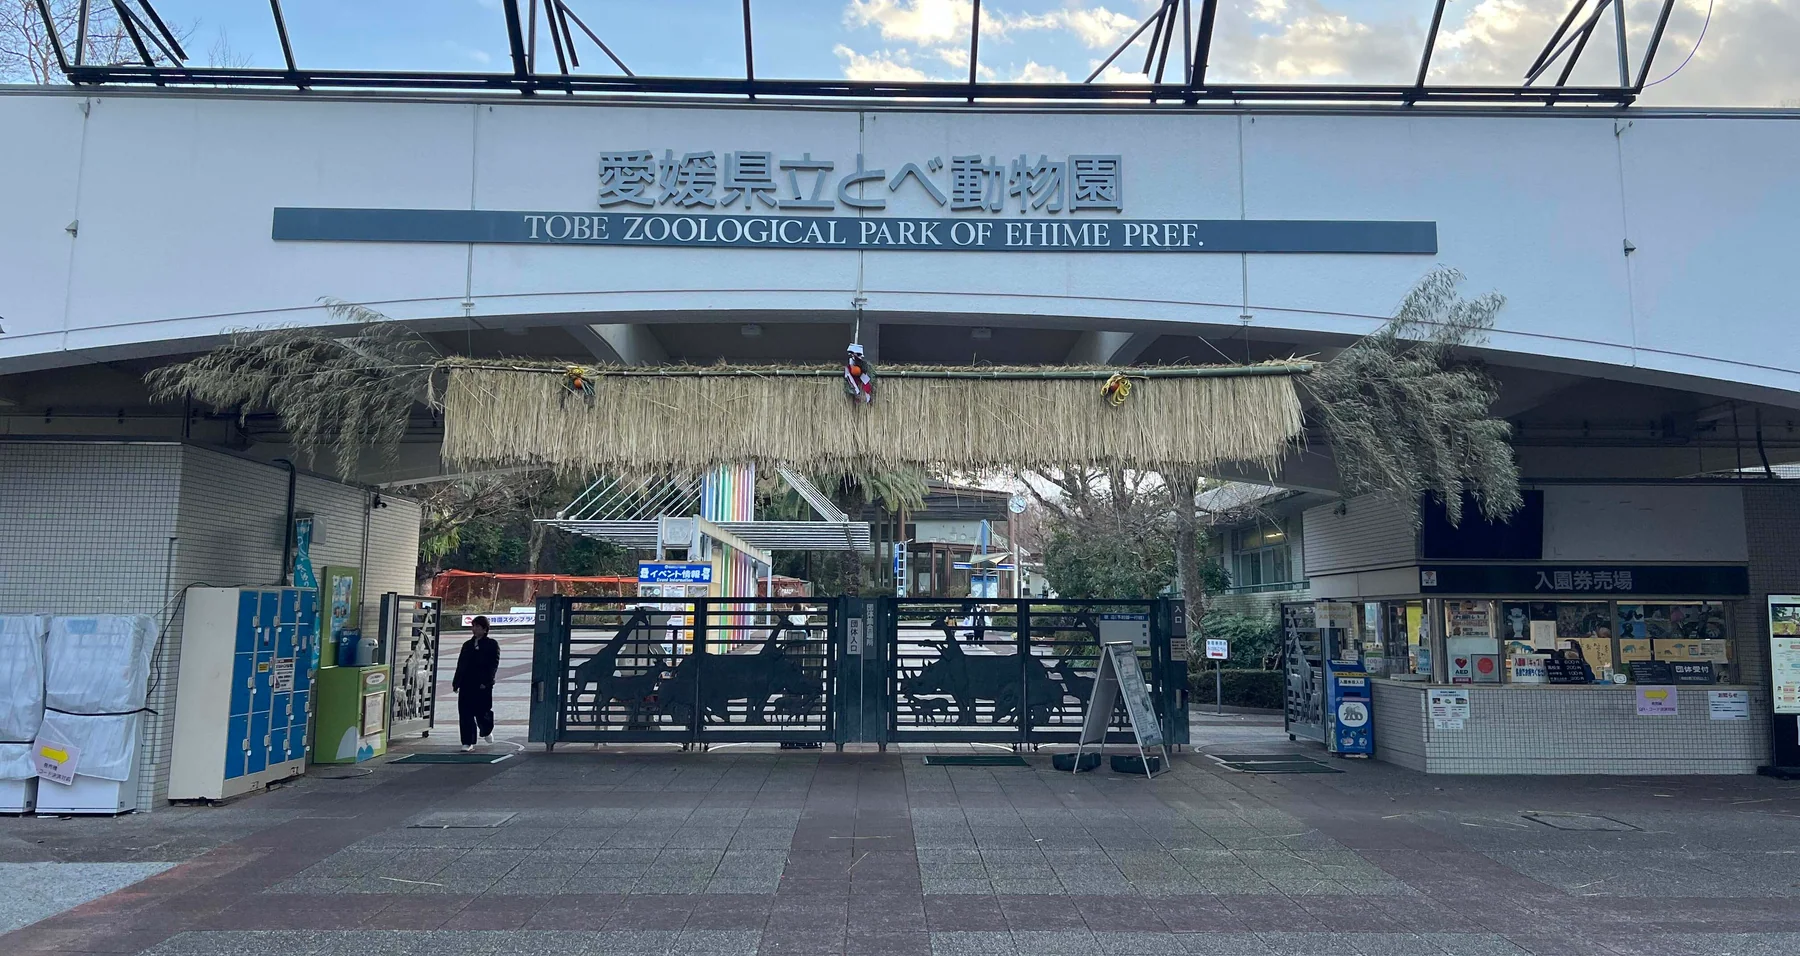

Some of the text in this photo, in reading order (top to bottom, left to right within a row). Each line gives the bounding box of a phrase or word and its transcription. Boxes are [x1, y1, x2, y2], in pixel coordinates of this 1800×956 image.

[598, 149, 1123, 213] 愛媛県立とべ動物園
[524, 215, 1204, 247] TOBE ZOOLOGICAL PARK OF EHIME PREF.
[650, 569, 700, 579] イベント情報
[1534, 571, 1633, 590] 入園券売場
[539, 603, 546, 621] 出口
[1174, 605, 1182, 624] 入口
[850, 619, 858, 652] 団体入口
[1675, 665, 1709, 674] 団体受付
